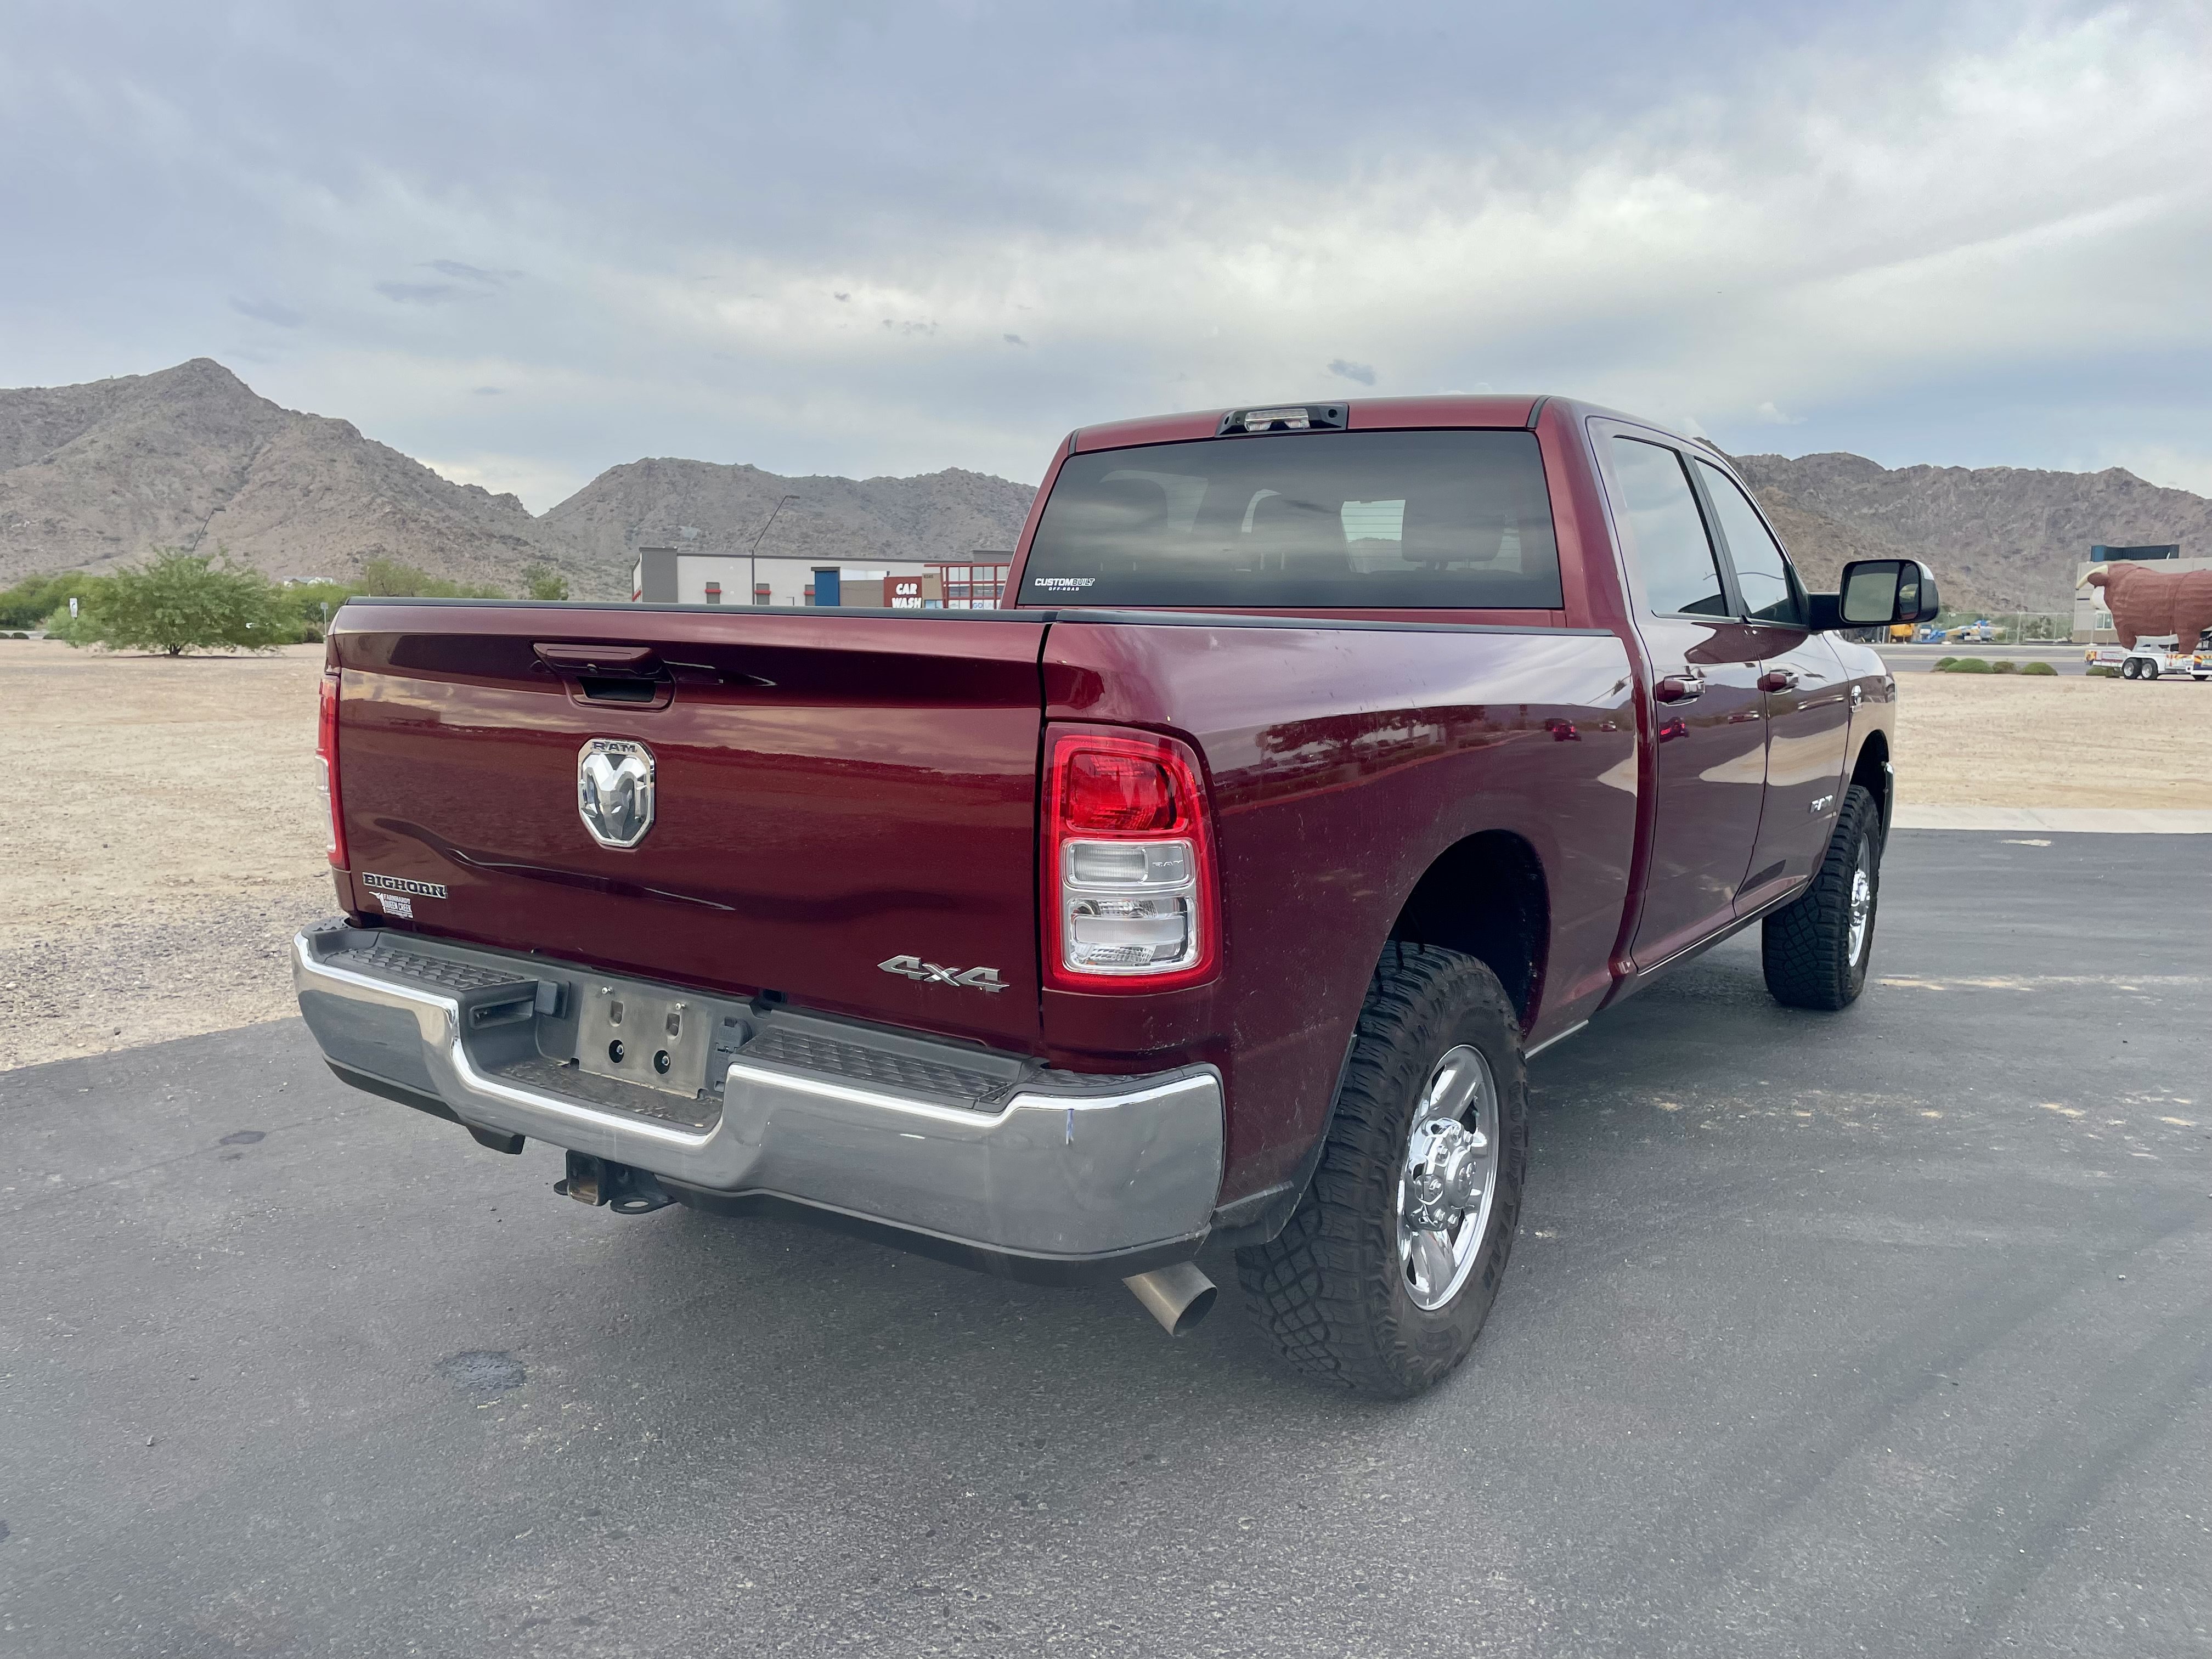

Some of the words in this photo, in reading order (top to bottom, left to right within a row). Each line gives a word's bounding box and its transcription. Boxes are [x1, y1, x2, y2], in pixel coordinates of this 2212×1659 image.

[895, 583, 918, 595] CAR
[891, 597, 922, 608] WASH
[592, 742, 636, 753] RAM
[362, 872, 448, 899] BIGHORN
